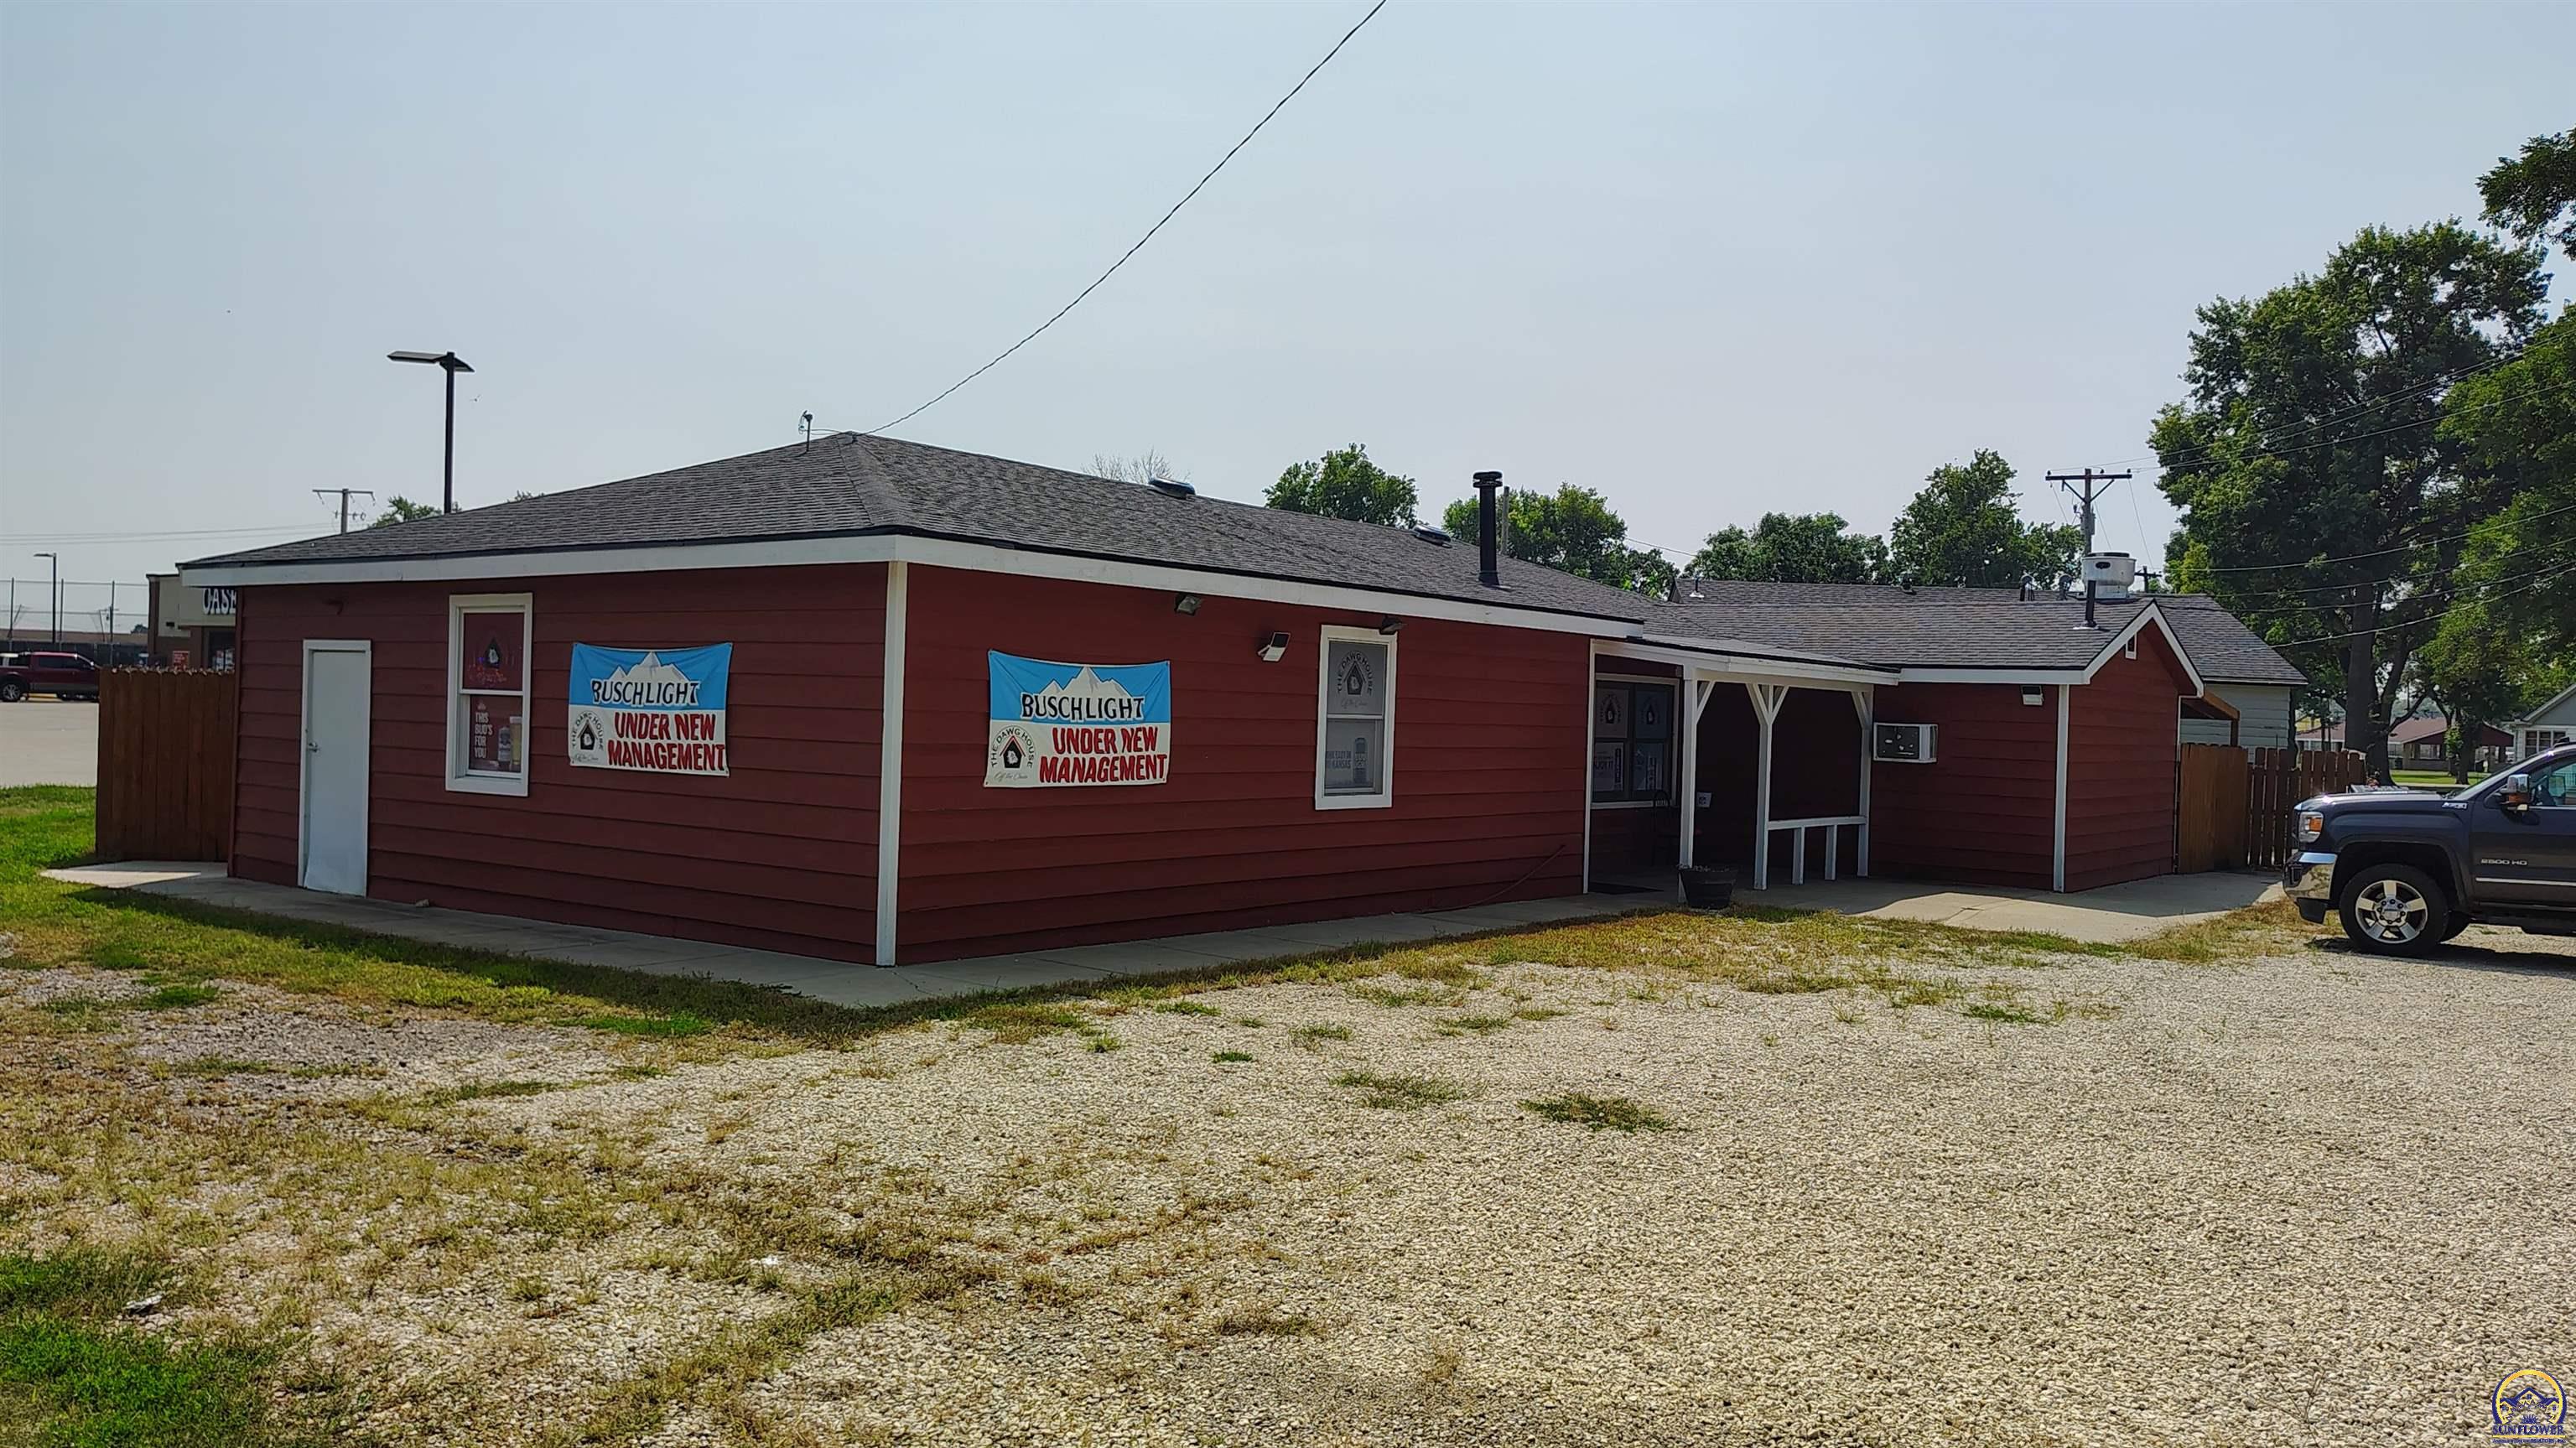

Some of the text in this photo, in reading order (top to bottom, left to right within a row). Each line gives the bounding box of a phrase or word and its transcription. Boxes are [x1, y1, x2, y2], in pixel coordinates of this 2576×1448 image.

[645, 681, 700, 706] LIGHT
[475, 712, 489, 723] THIS
[1085, 697, 1145, 719] LIGHT
[614, 712, 716, 741] UNDER NEW
[474, 735, 487, 747] FOR
[474, 746, 487, 759] YOU
[996, 728, 1021, 744] DAWG
[1021, 732, 1034, 769] HOUSE
[1052, 727, 1159, 755] UNDER NEW
[607, 740, 725, 771] MANAGEMENT
[1039, 754, 1168, 784] MANAGEMENT
